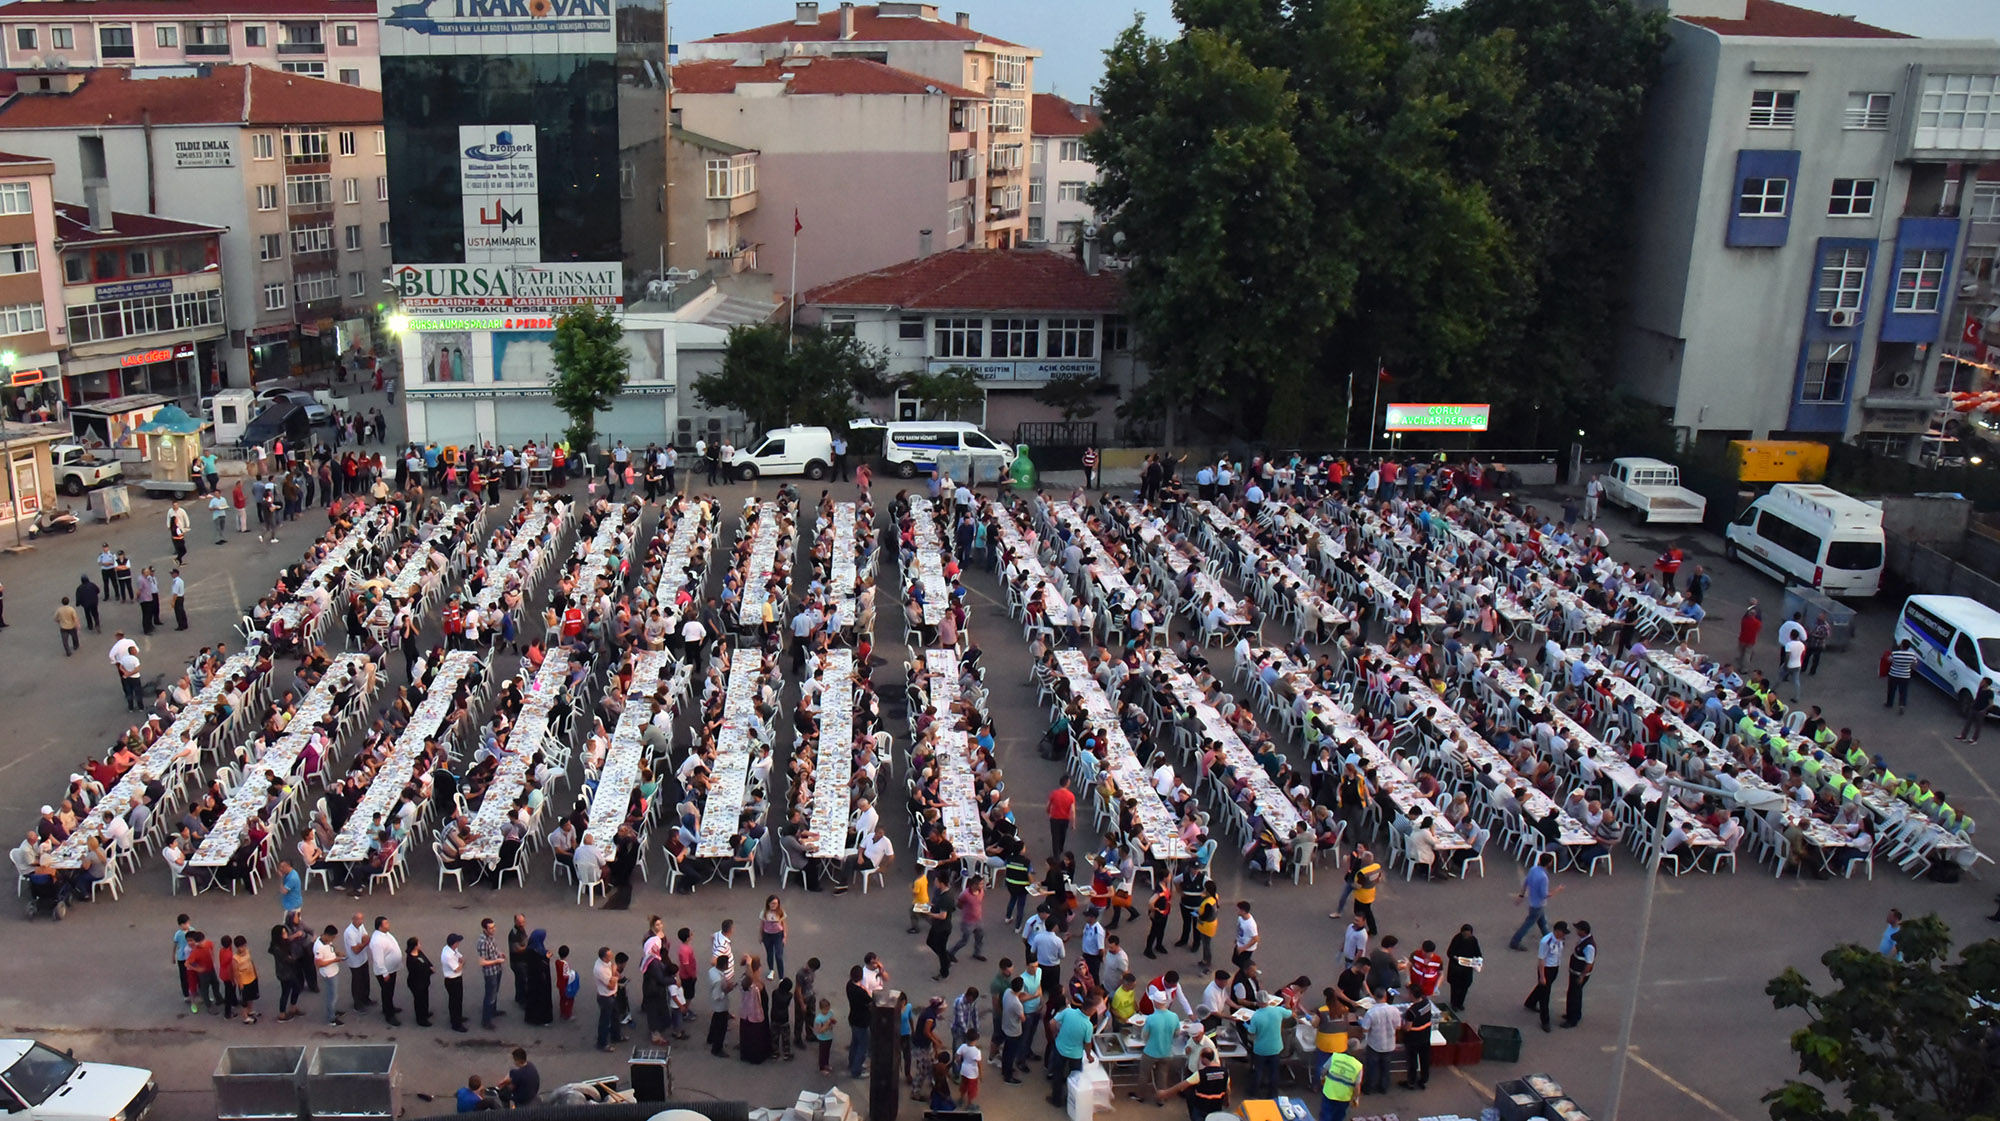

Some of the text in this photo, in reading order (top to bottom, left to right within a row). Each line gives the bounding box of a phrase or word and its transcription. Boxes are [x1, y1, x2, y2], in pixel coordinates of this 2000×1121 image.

[175, 140, 230, 151] YILDIZ EMLAK
[489, 143, 534, 153] Promerk
[467, 235, 537, 247] USTAMİMARLIK
[400, 268, 511, 297] BURSA
[517, 271, 553, 285] YAPI
[484, 298, 507, 306] KAT
[408, 319, 438, 330] BURSA
[121, 353, 145, 367] LALE
[1038, 364, 1058, 372] AÇIK
[1401, 415, 1443, 425] AVCILAR
